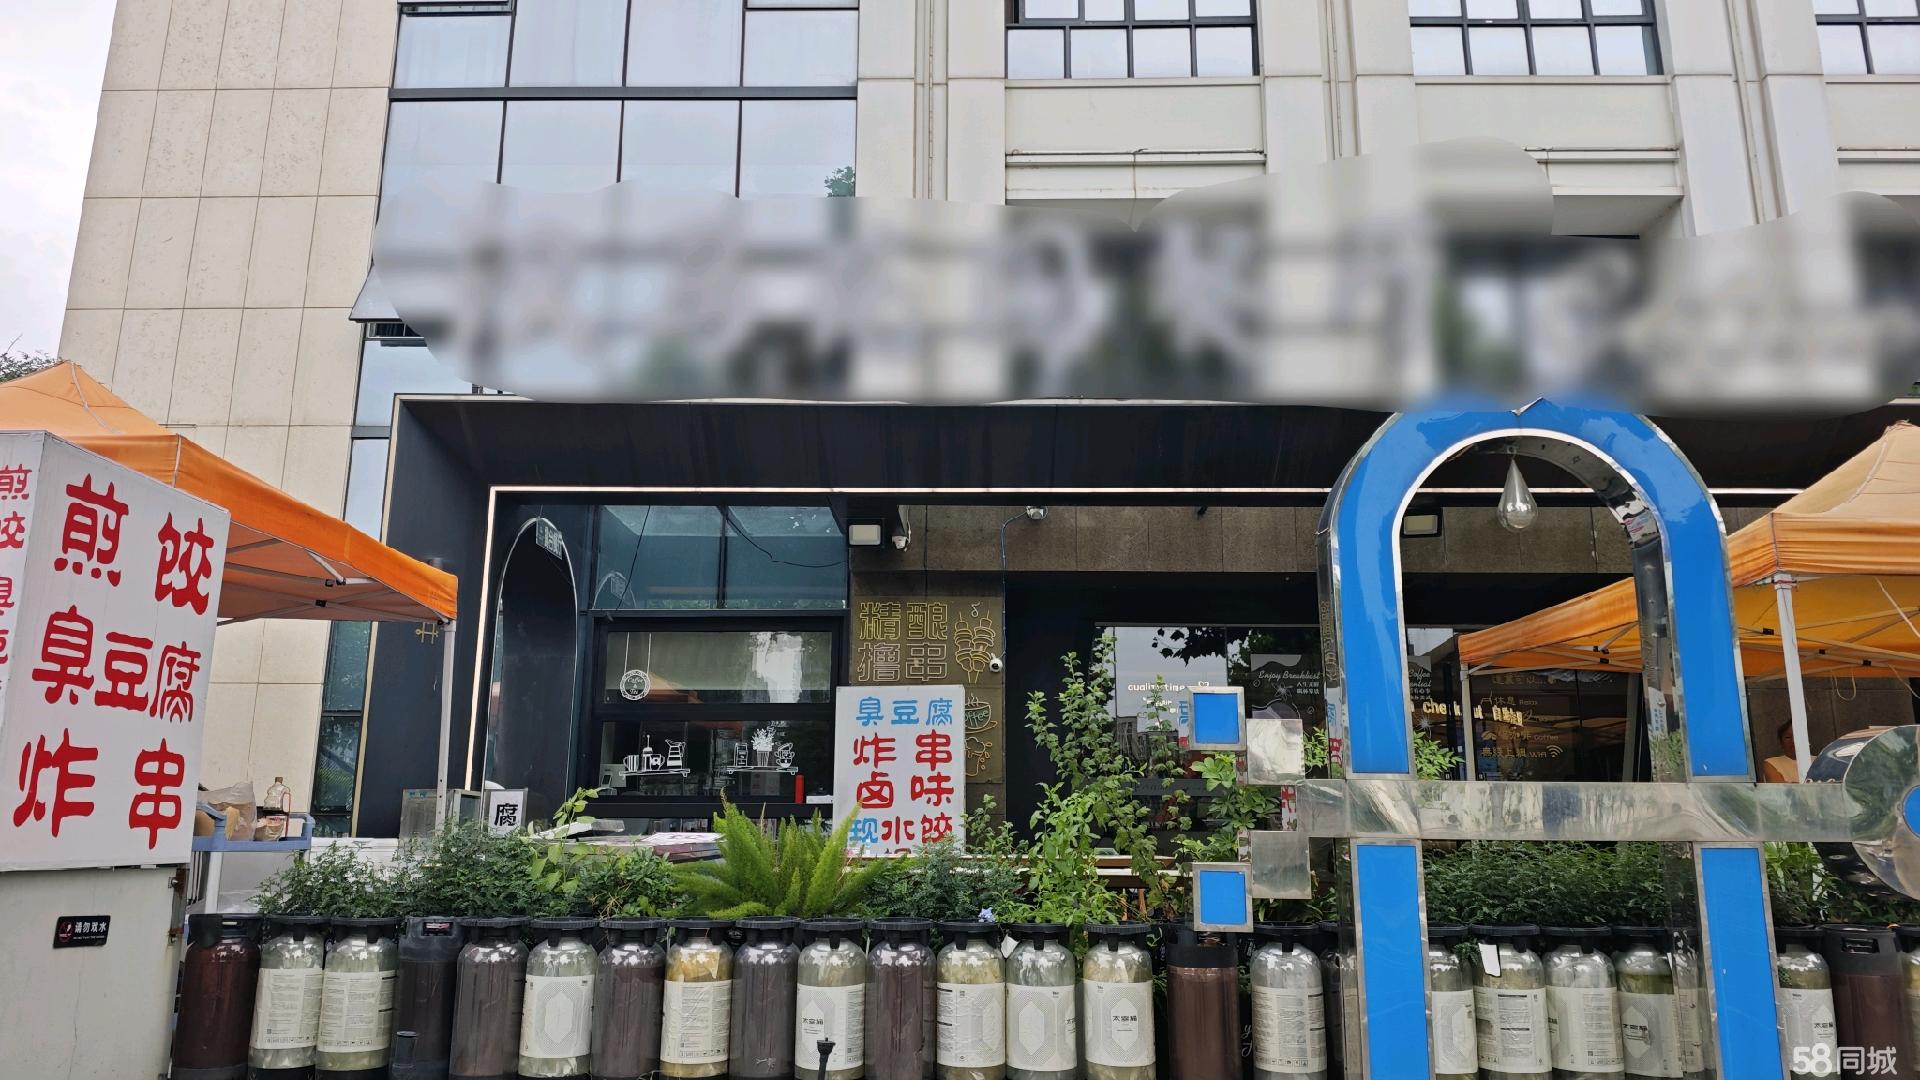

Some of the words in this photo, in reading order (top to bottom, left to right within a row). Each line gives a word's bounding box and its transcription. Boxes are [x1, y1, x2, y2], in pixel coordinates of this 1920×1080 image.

[54, 473, 215, 615] 煎饺
[859, 602, 948, 640] 精酿
[31, 604, 201, 723] 臭豆腐
[856, 697, 953, 726] 臭豆腐
[853, 729, 953, 771] 炸串
[13, 728, 186, 850] 炸串
[857, 771, 955, 809] 卤味
[494, 803, 519, 827] 腐
